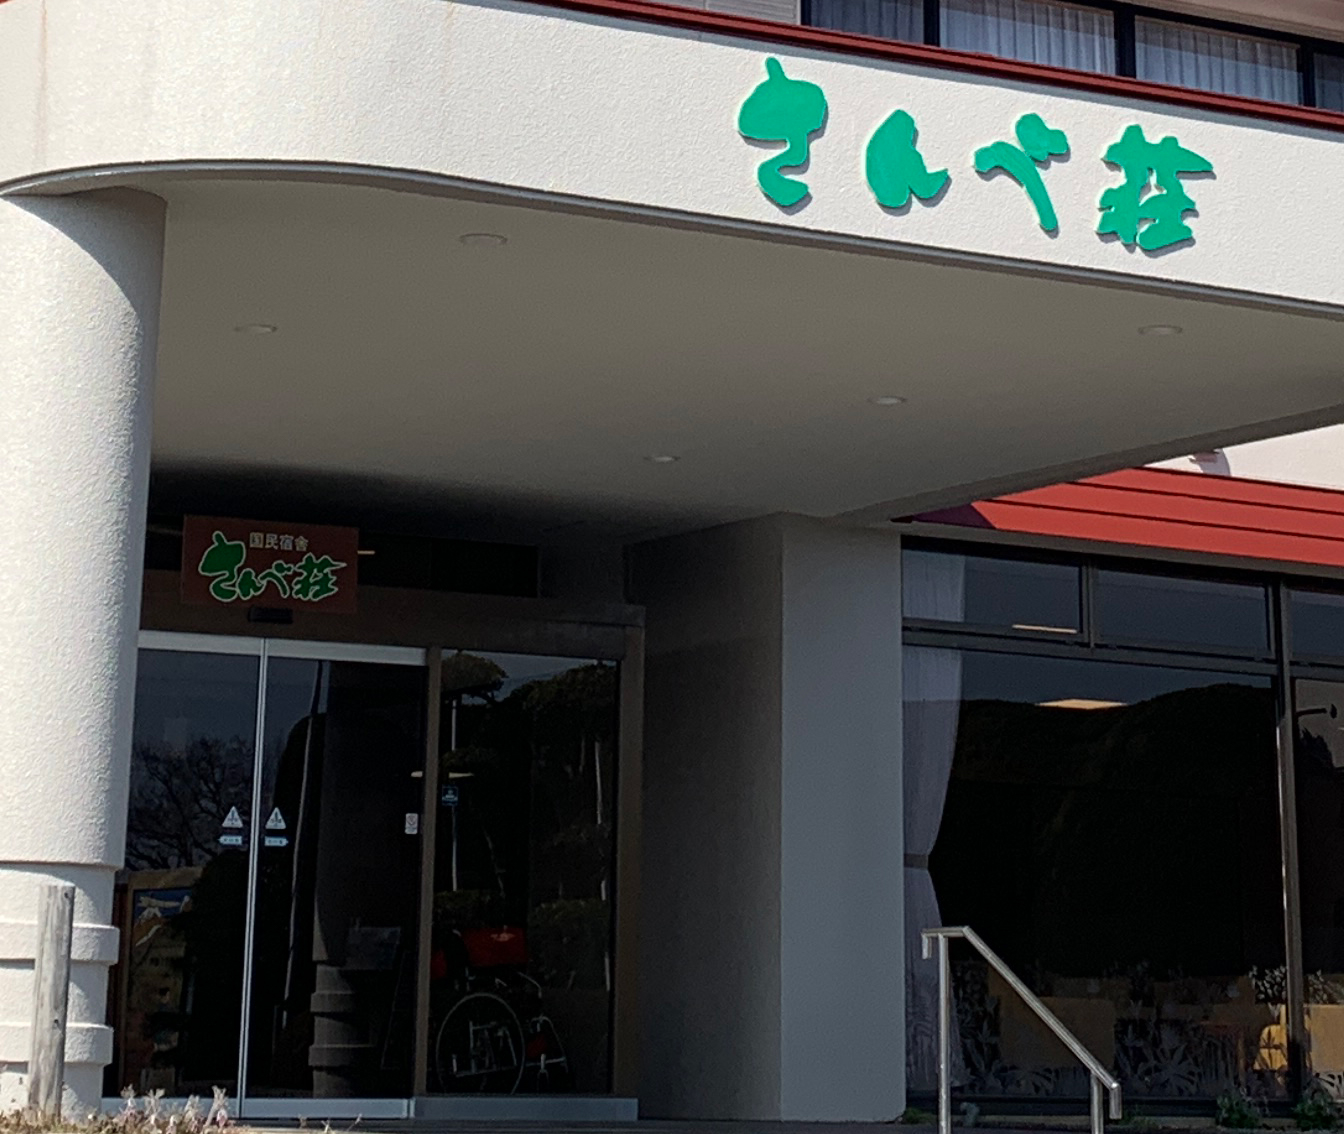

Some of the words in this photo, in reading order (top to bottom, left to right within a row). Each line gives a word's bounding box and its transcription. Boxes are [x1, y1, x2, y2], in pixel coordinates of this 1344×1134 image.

[737, 57, 1214, 251] さんべ荘
[198, 530, 347, 602] さんべ荘
[249, 532, 309, 551] 国民宿舎
